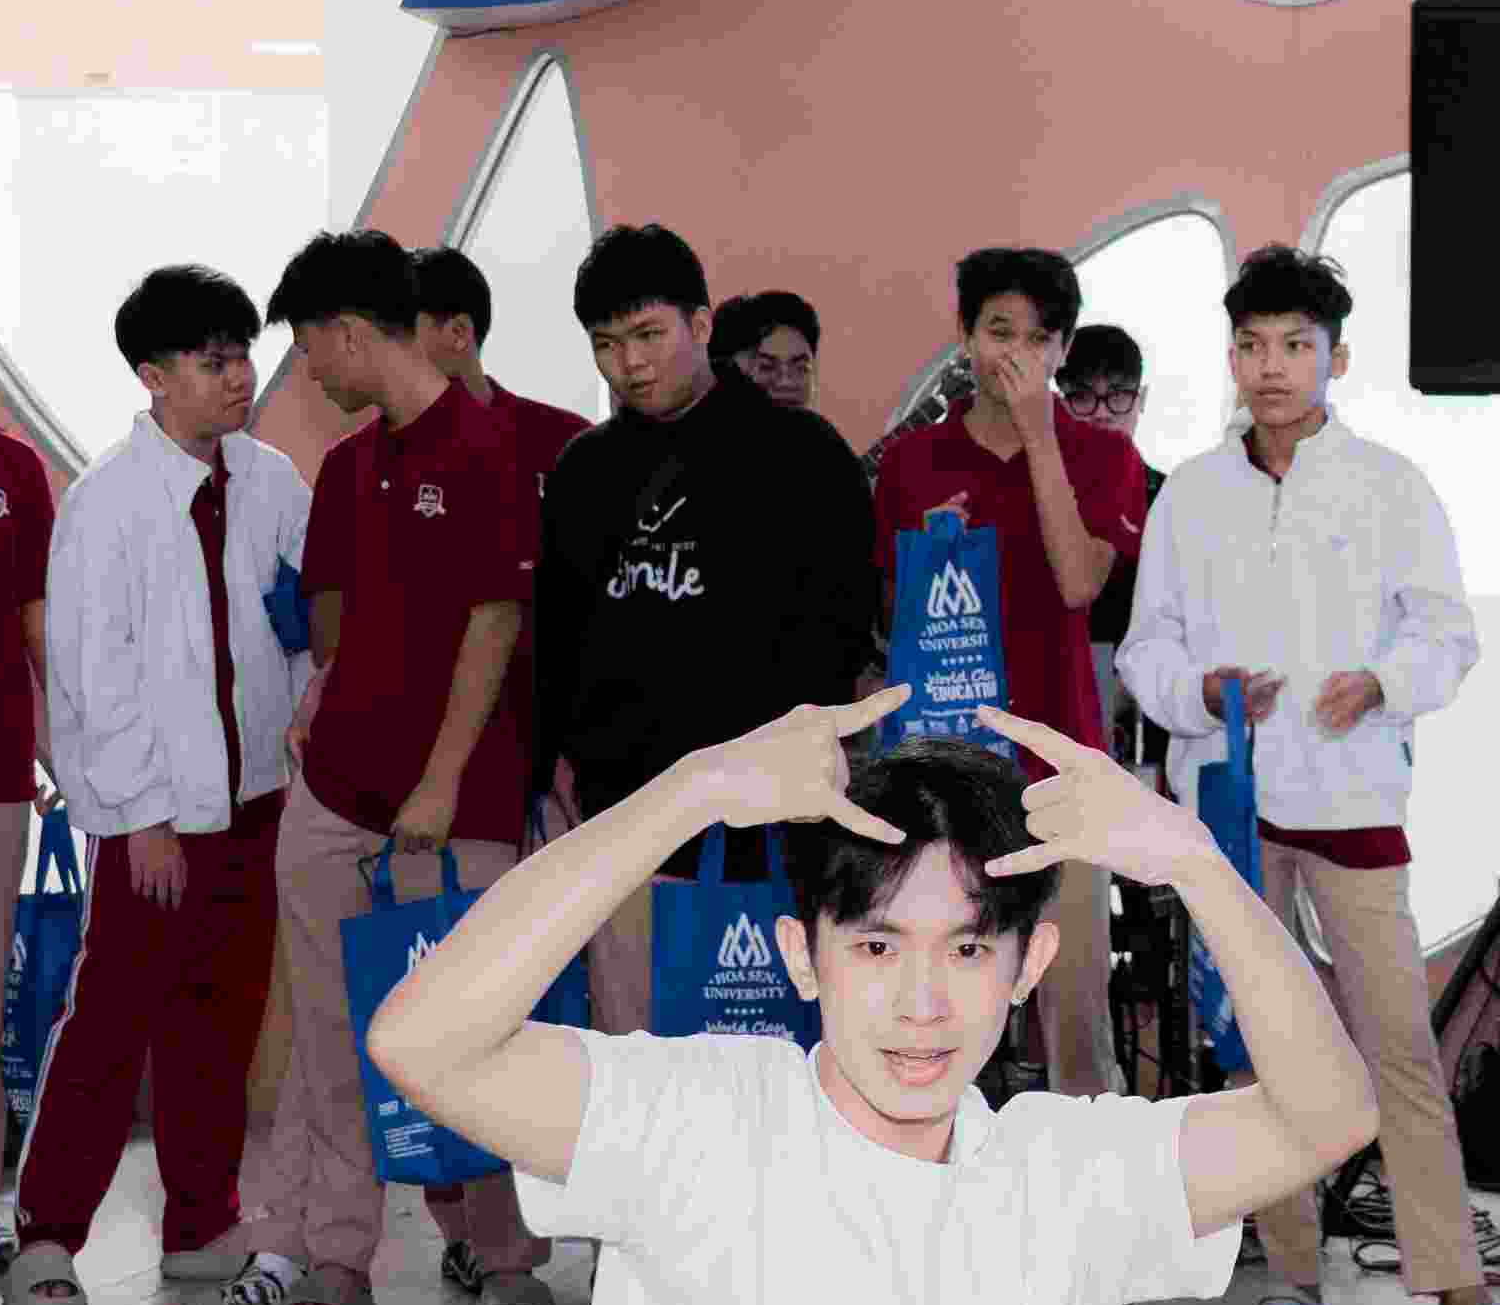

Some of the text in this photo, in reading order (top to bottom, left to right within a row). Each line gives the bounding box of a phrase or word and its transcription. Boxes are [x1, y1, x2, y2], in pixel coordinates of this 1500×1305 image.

[714, 970, 775, 985] HOA SEN
[703, 985, 788, 1000] UNIVERSITY
